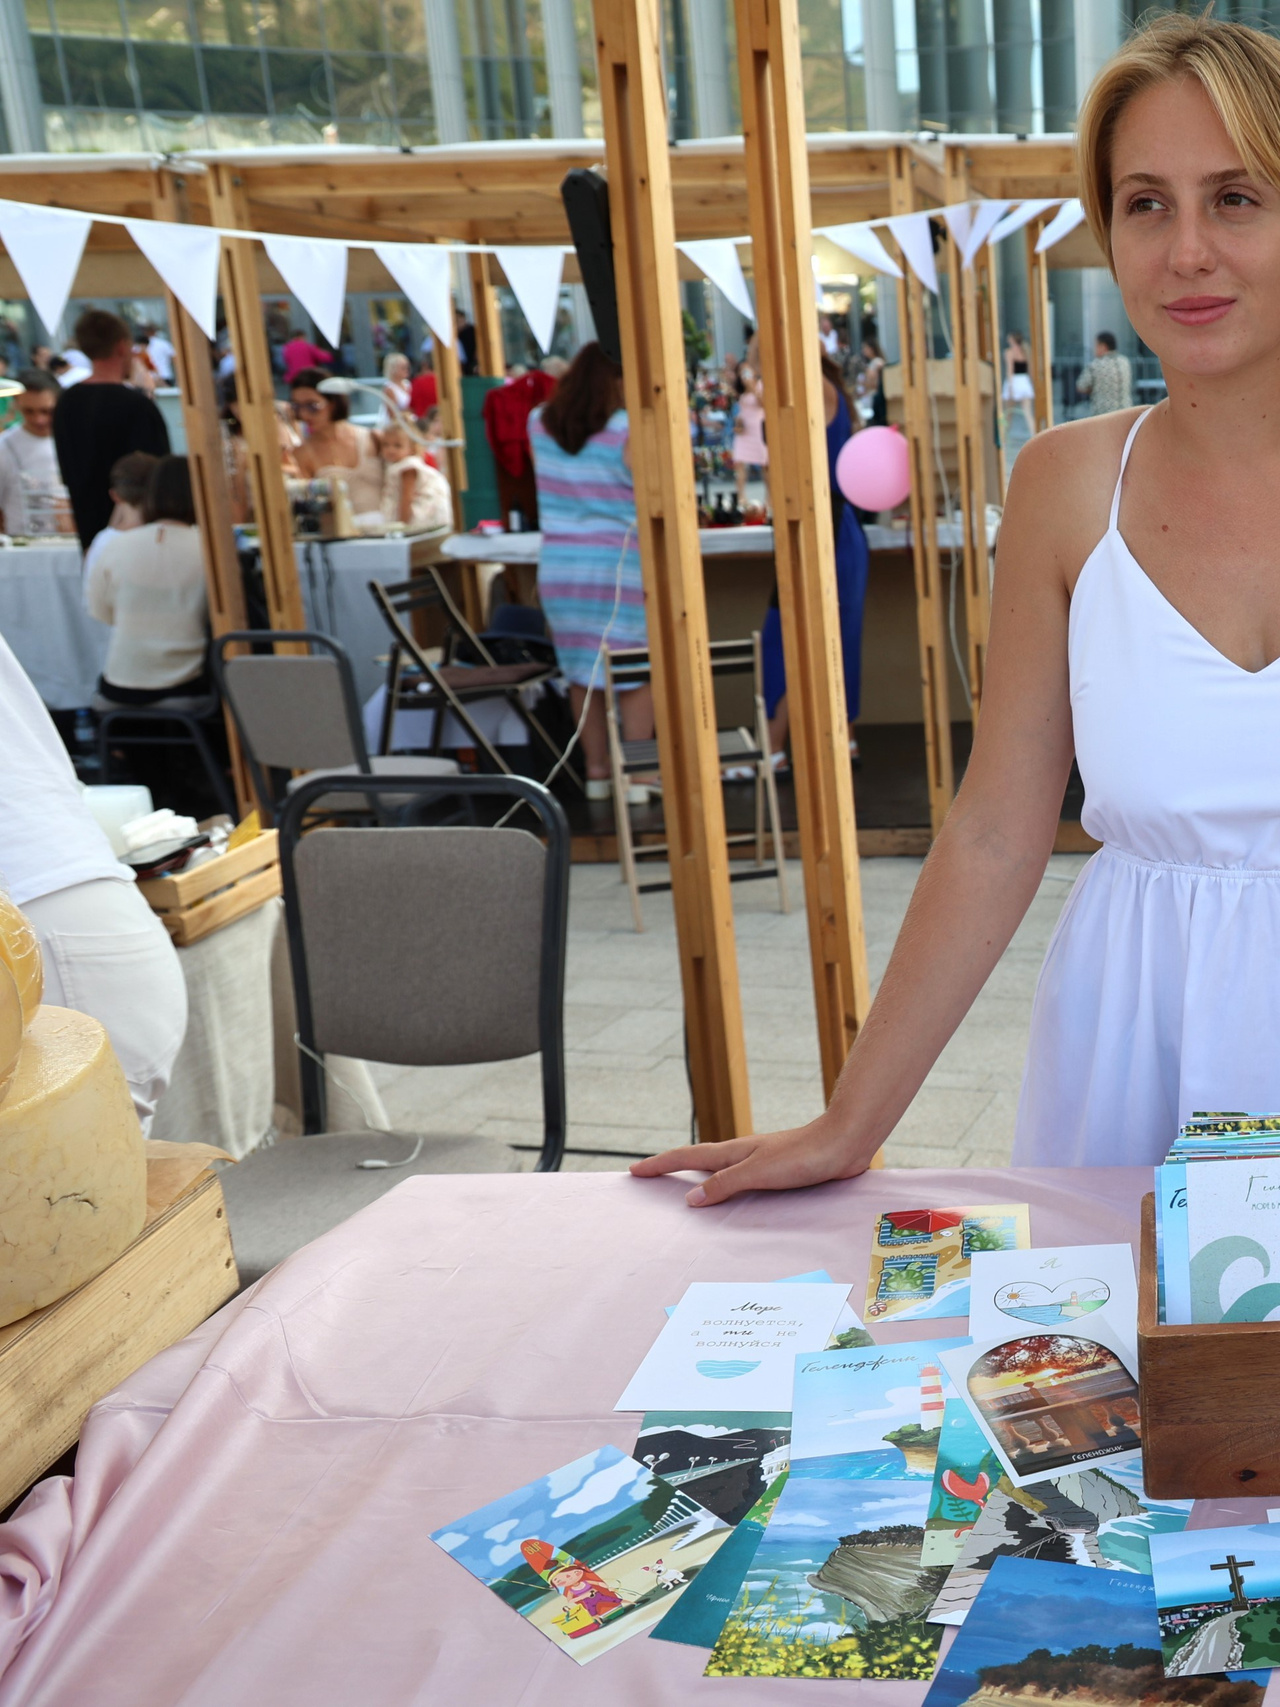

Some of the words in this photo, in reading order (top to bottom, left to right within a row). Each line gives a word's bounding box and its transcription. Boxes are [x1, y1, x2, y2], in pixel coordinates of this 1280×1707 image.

[730, 1301, 783, 1315] Море
[696, 1340, 782, 1348] волнуйся
[1071, 1445, 1124, 1462] ГЕЛЕНДЖИК
